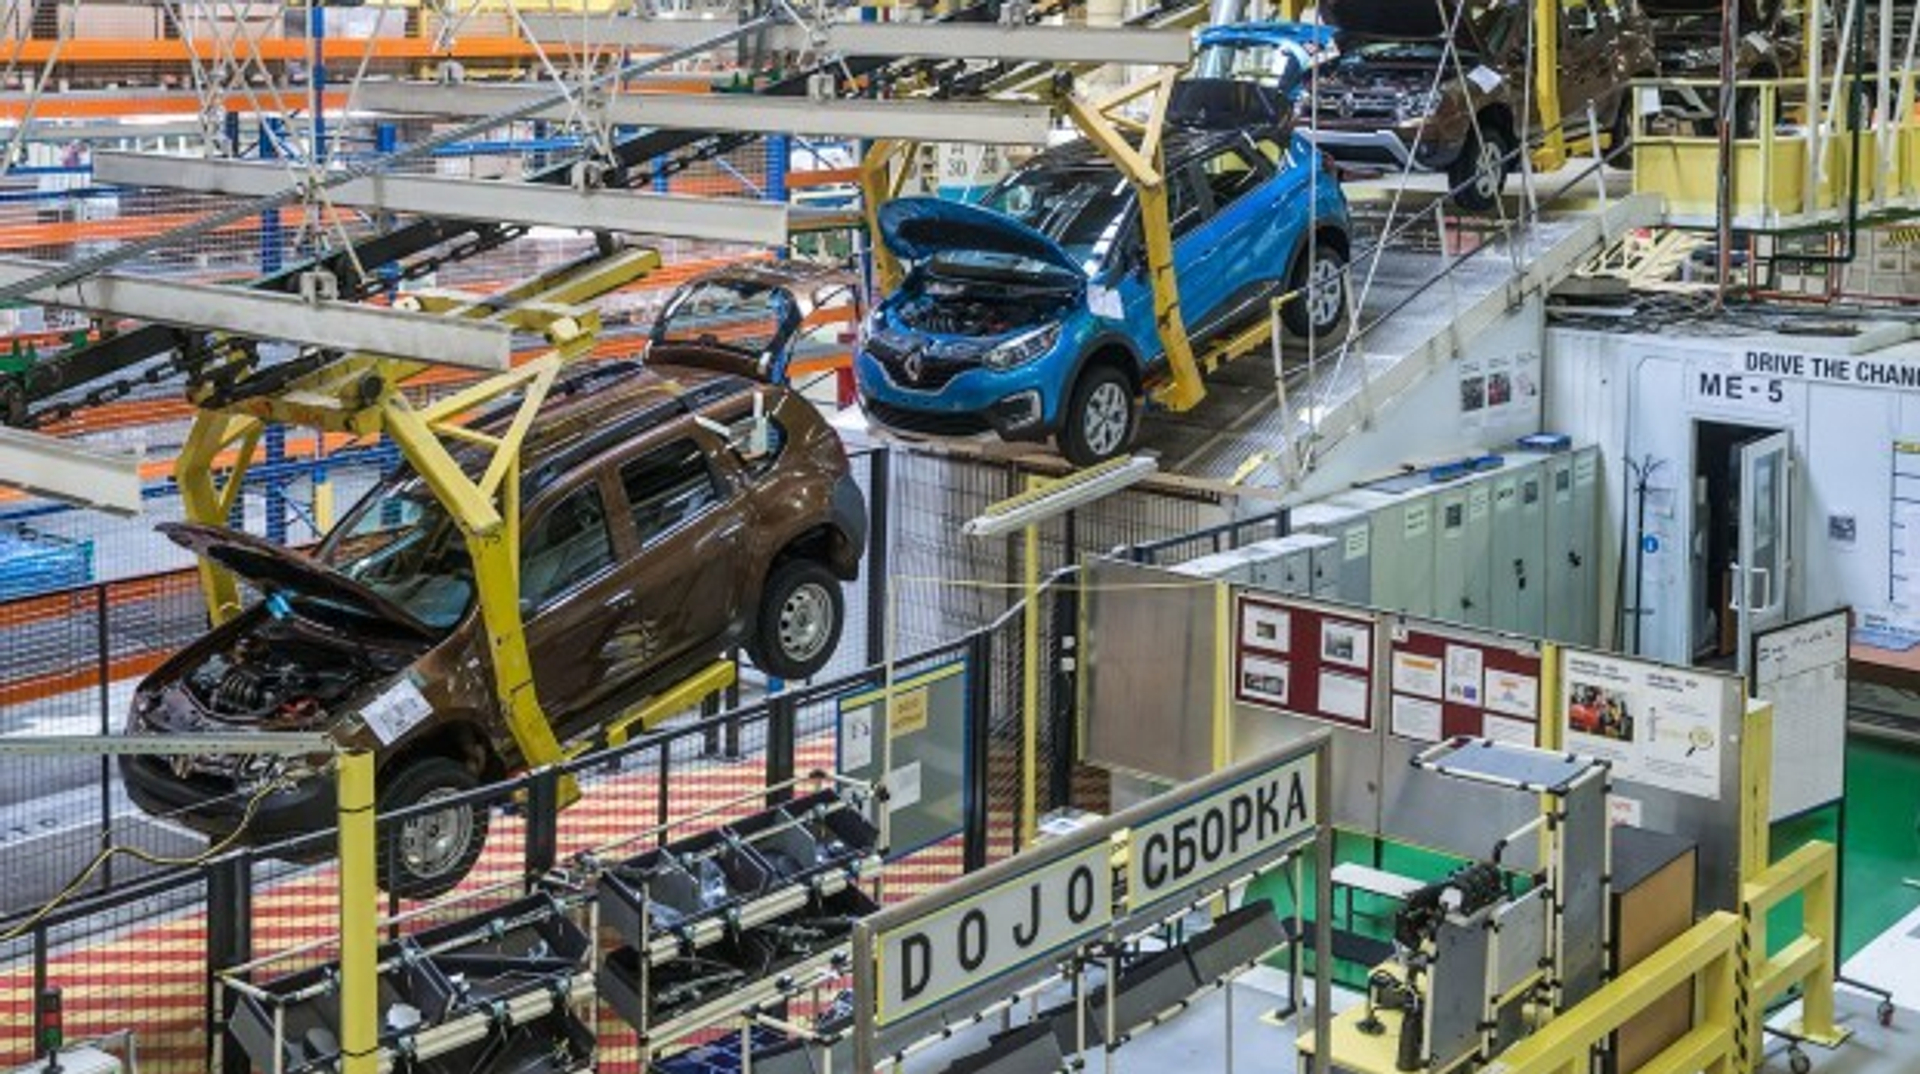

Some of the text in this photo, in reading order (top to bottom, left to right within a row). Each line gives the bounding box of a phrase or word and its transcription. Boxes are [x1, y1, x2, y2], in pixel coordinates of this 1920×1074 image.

[1746, 351, 1920, 387] DRIVE THE CHAN
[1768, 379, 1783, 402] 5
[1141, 771, 1308, 890] СБОРКА
[902, 864, 1095, 1000] DOJO
